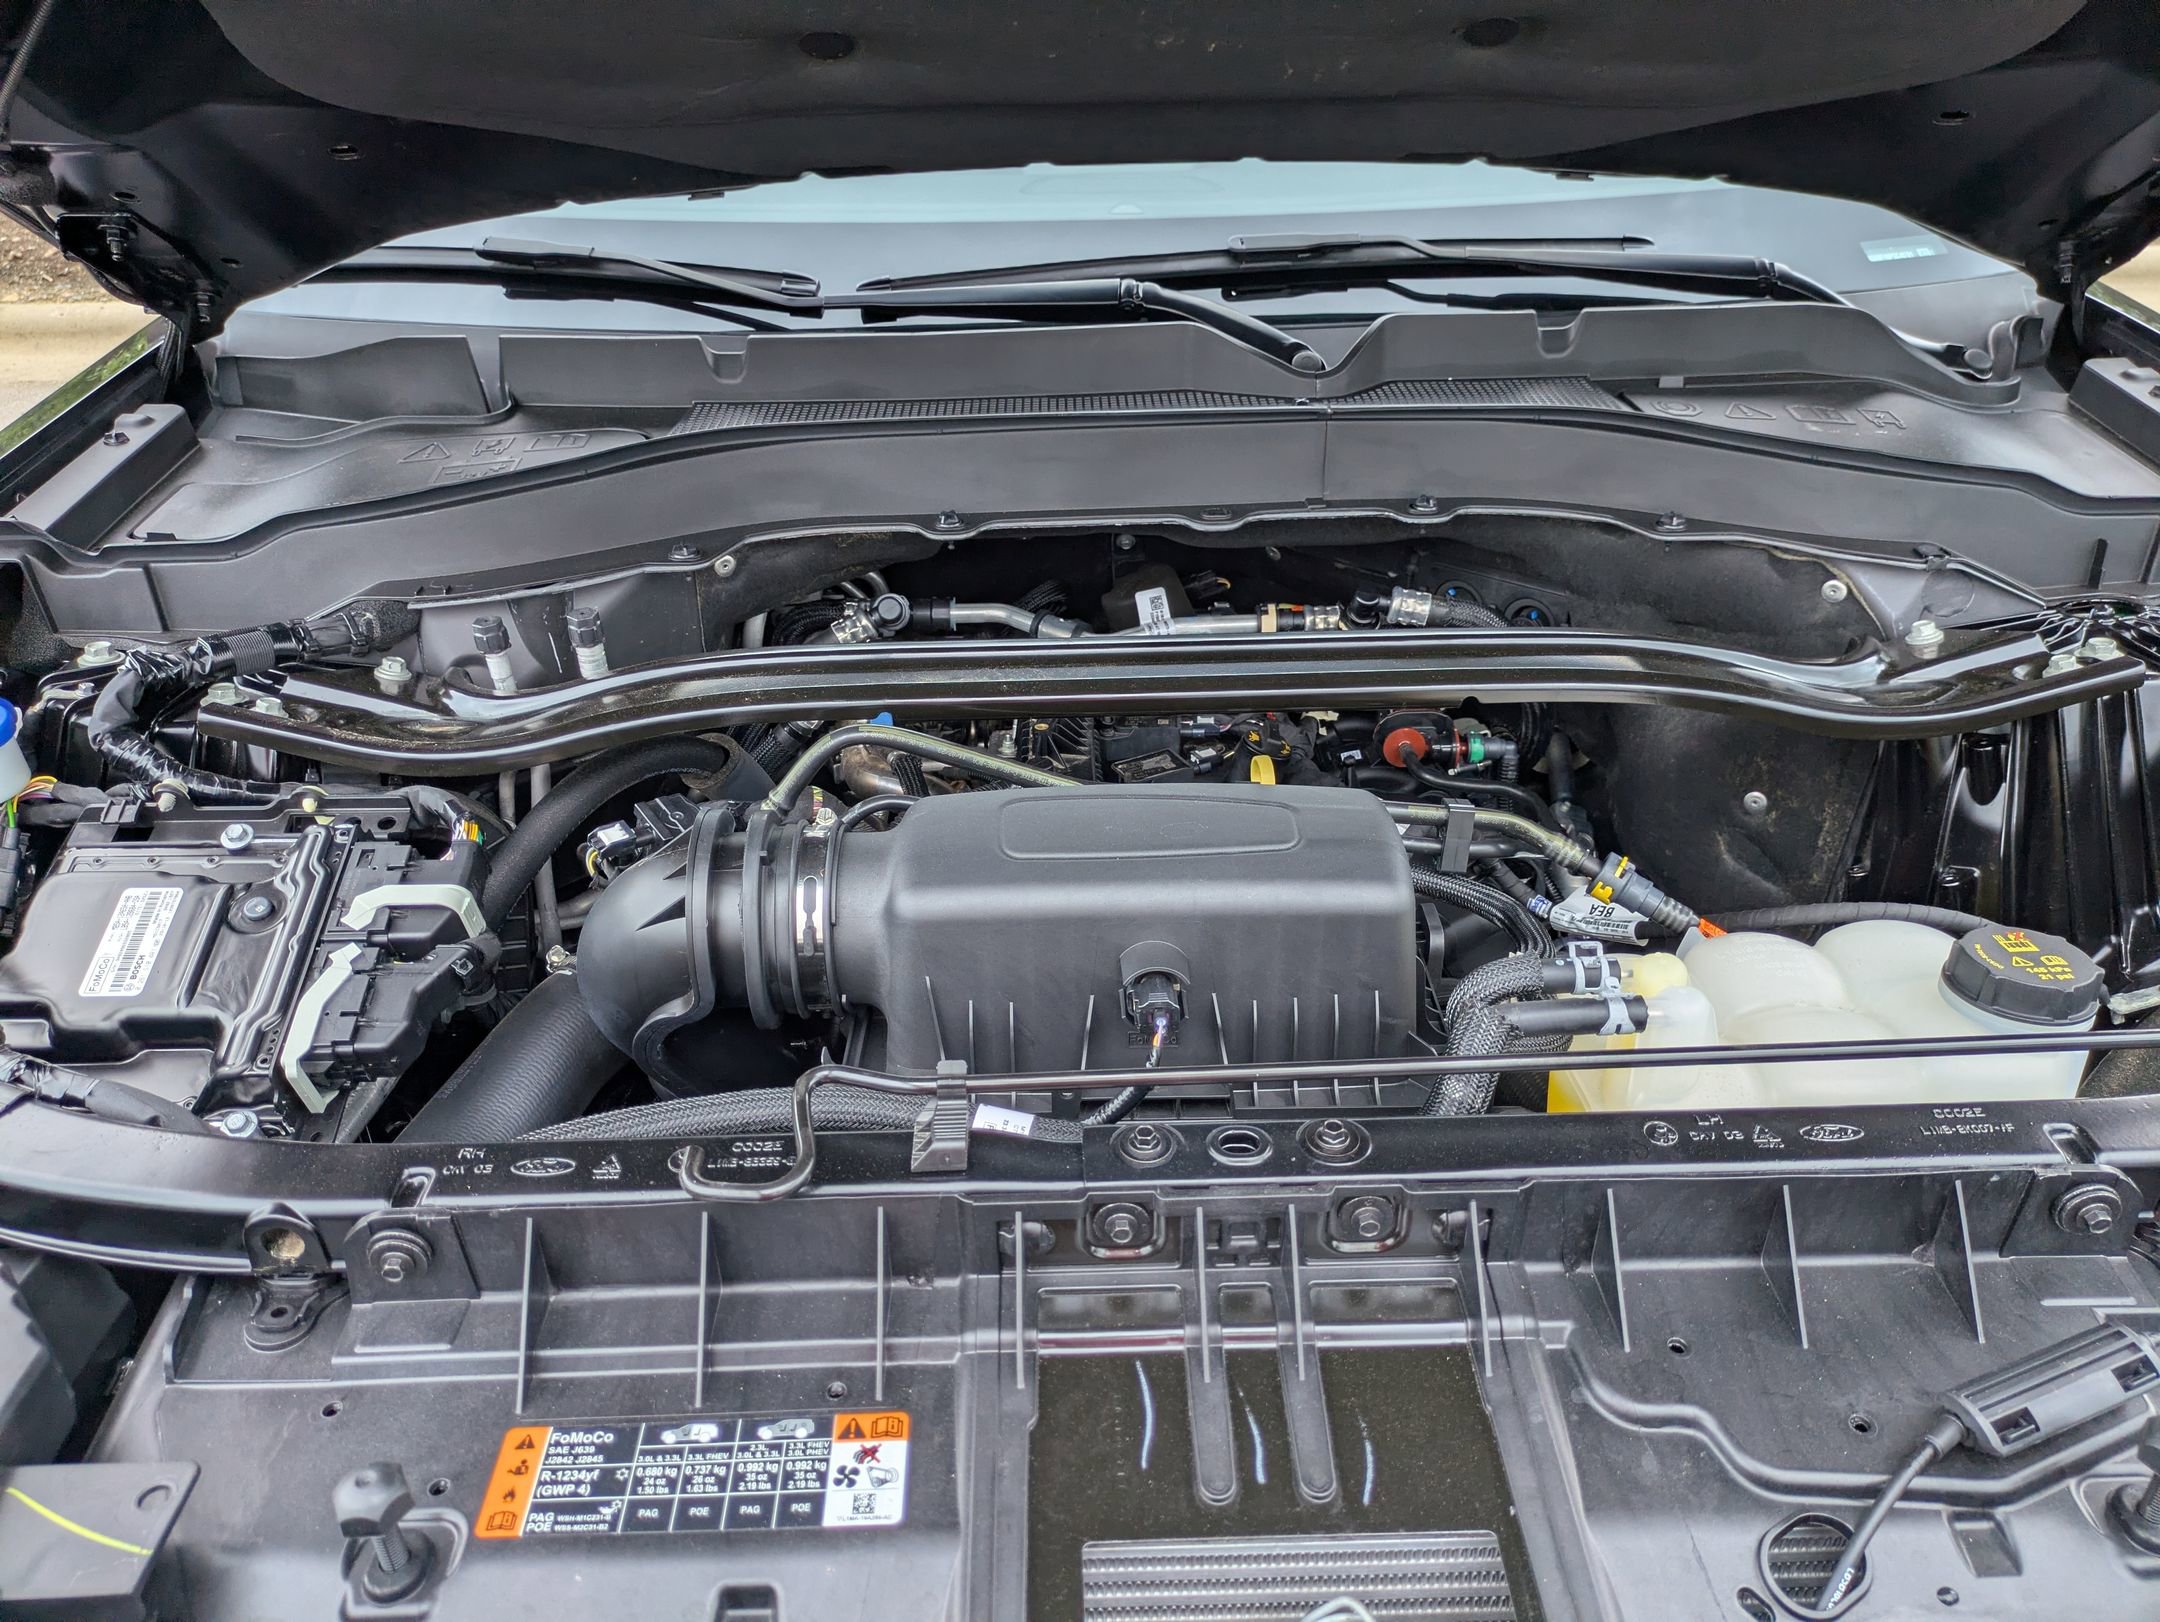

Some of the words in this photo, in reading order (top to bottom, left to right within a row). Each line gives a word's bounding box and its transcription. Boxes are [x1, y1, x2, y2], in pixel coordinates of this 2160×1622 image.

[1589, 904, 1615, 918] BEA
[129, 954, 146, 980] BOSCH
[88, 958, 111, 992] FoMoCo
[550, 1430, 614, 1445] FoMoCo
[548, 1446, 569, 1455] SAE
[572, 1446, 596, 1454] J639
[763, 1450, 780, 1458] 3.3L
[545, 1456, 574, 1464] J2842
[575, 1455, 604, 1464] J2845
[664, 1454, 682, 1462] 3.3L
[706, 1452, 730, 1460] FHEV
[685, 1465, 712, 1474] 0.737
[714, 1464, 726, 1476] kg
[737, 1462, 764, 1472] 0.992
[766, 1462, 778, 1473] kg
[786, 1460, 812, 1470] 0.992
[814, 1460, 827, 1471] kg
[540, 1468, 600, 1483] R-1234yf
[636, 1466, 663, 1476] 0.680
[665, 1466, 678, 1478] kg
[794, 1471, 804, 1479] 35
[745, 1473, 756, 1481] 35
[686, 1485, 704, 1493] 1.63
[705, 1484, 718, 1492] lbs
[738, 1482, 757, 1490] 2.19
[758, 1481, 771, 1490] lbs
[787, 1481, 805, 1489] 2.19
[807, 1480, 820, 1488] lbs
[536, 1485, 575, 1498] (GWP
[576, 1484, 591, 1497] 4)
[637, 1486, 655, 1494] 1.50
[656, 1486, 669, 1494] lbs
[689, 1507, 710, 1516] POE
[739, 1505, 761, 1514] PAG
[790, 1503, 811, 1512] POE
[529, 1512, 554, 1522] PAG
[638, 1508, 659, 1518] PAG
[526, 1522, 552, 1532] POE
